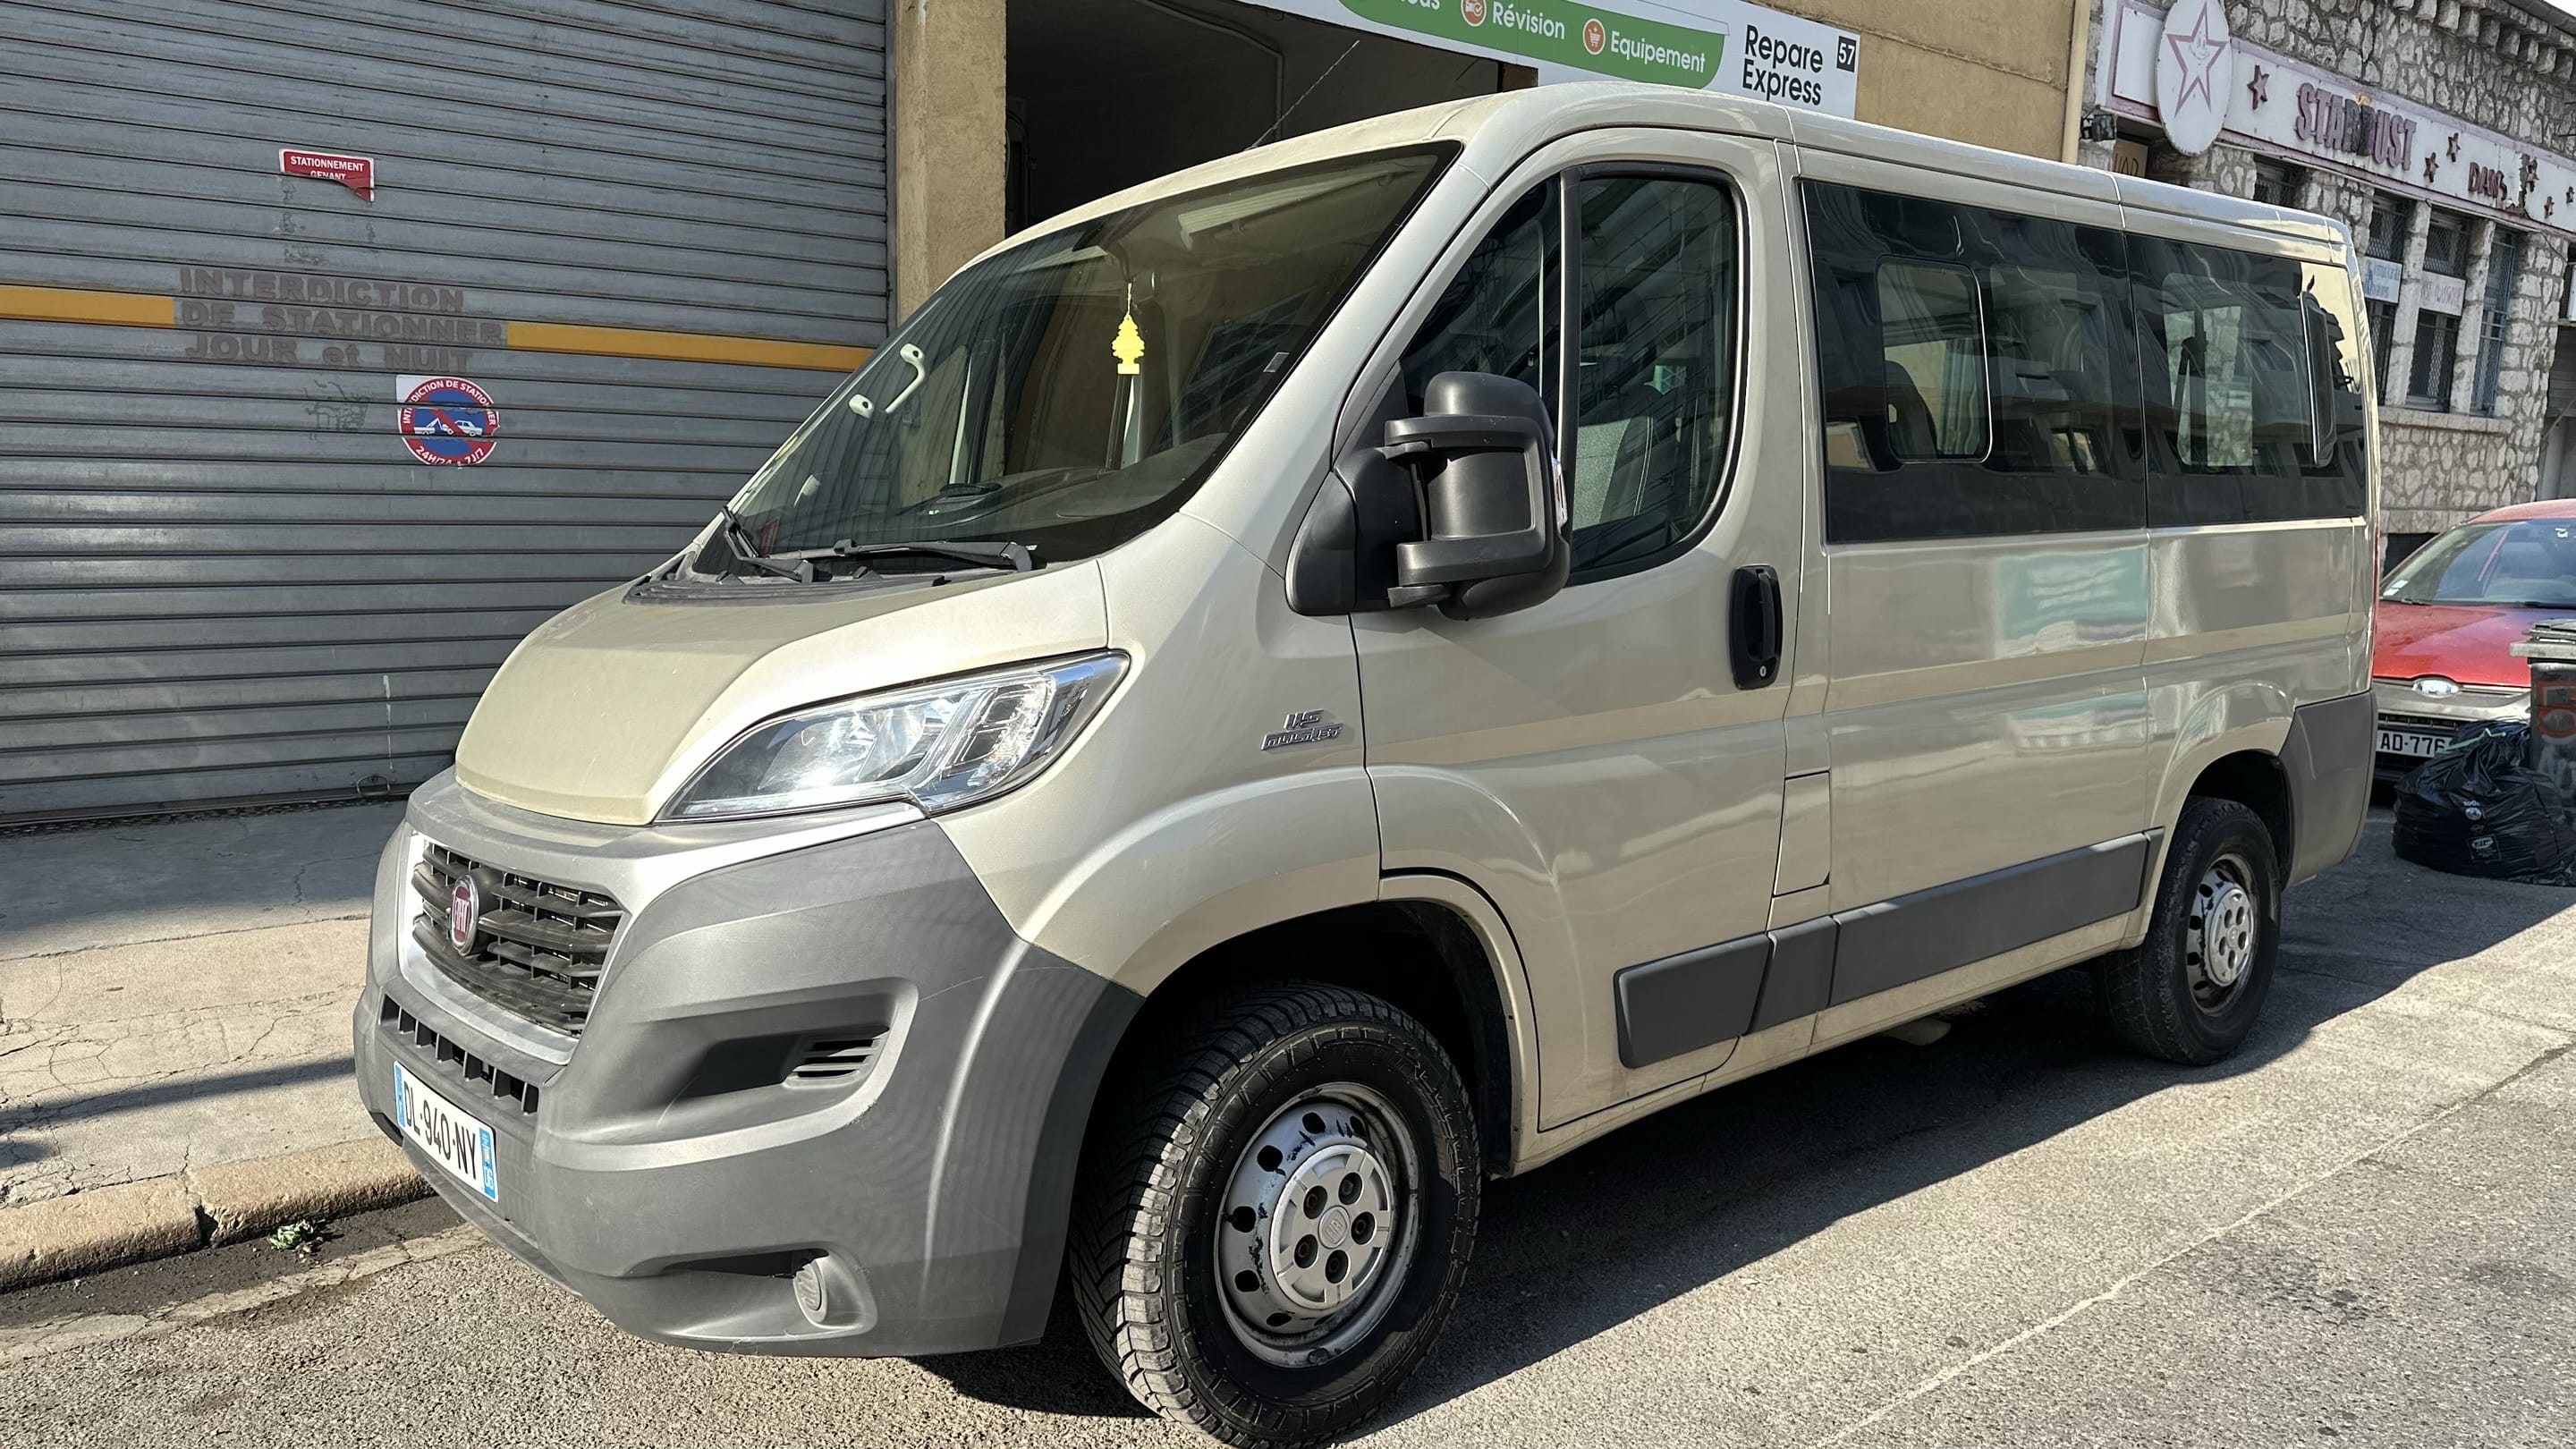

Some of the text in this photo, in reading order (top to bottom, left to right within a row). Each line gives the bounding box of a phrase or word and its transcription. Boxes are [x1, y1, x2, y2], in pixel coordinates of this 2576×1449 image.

[1491, 8, 1565, 40] Révision
[1610, 30, 1706, 73] Equipement
[1743, 23, 1824, 73] Repare
[1837, 42, 1856, 66] 57
[1741, 58, 1823, 106] Express
[2295, 81, 2418, 172] STARDUST
[290, 155, 364, 173] STATIONNEMENT
[181, 267, 464, 313] INTERDICTION
[182, 300, 504, 344] DE STATIONNER
[185, 333, 474, 374] JOUR et NUIT
[402, 380, 445, 424] INTDICTION
[446, 379, 459, 389] DE
[464, 447, 485, 464] 7J/7
[403, 1080, 477, 1181] DL-940-NY
